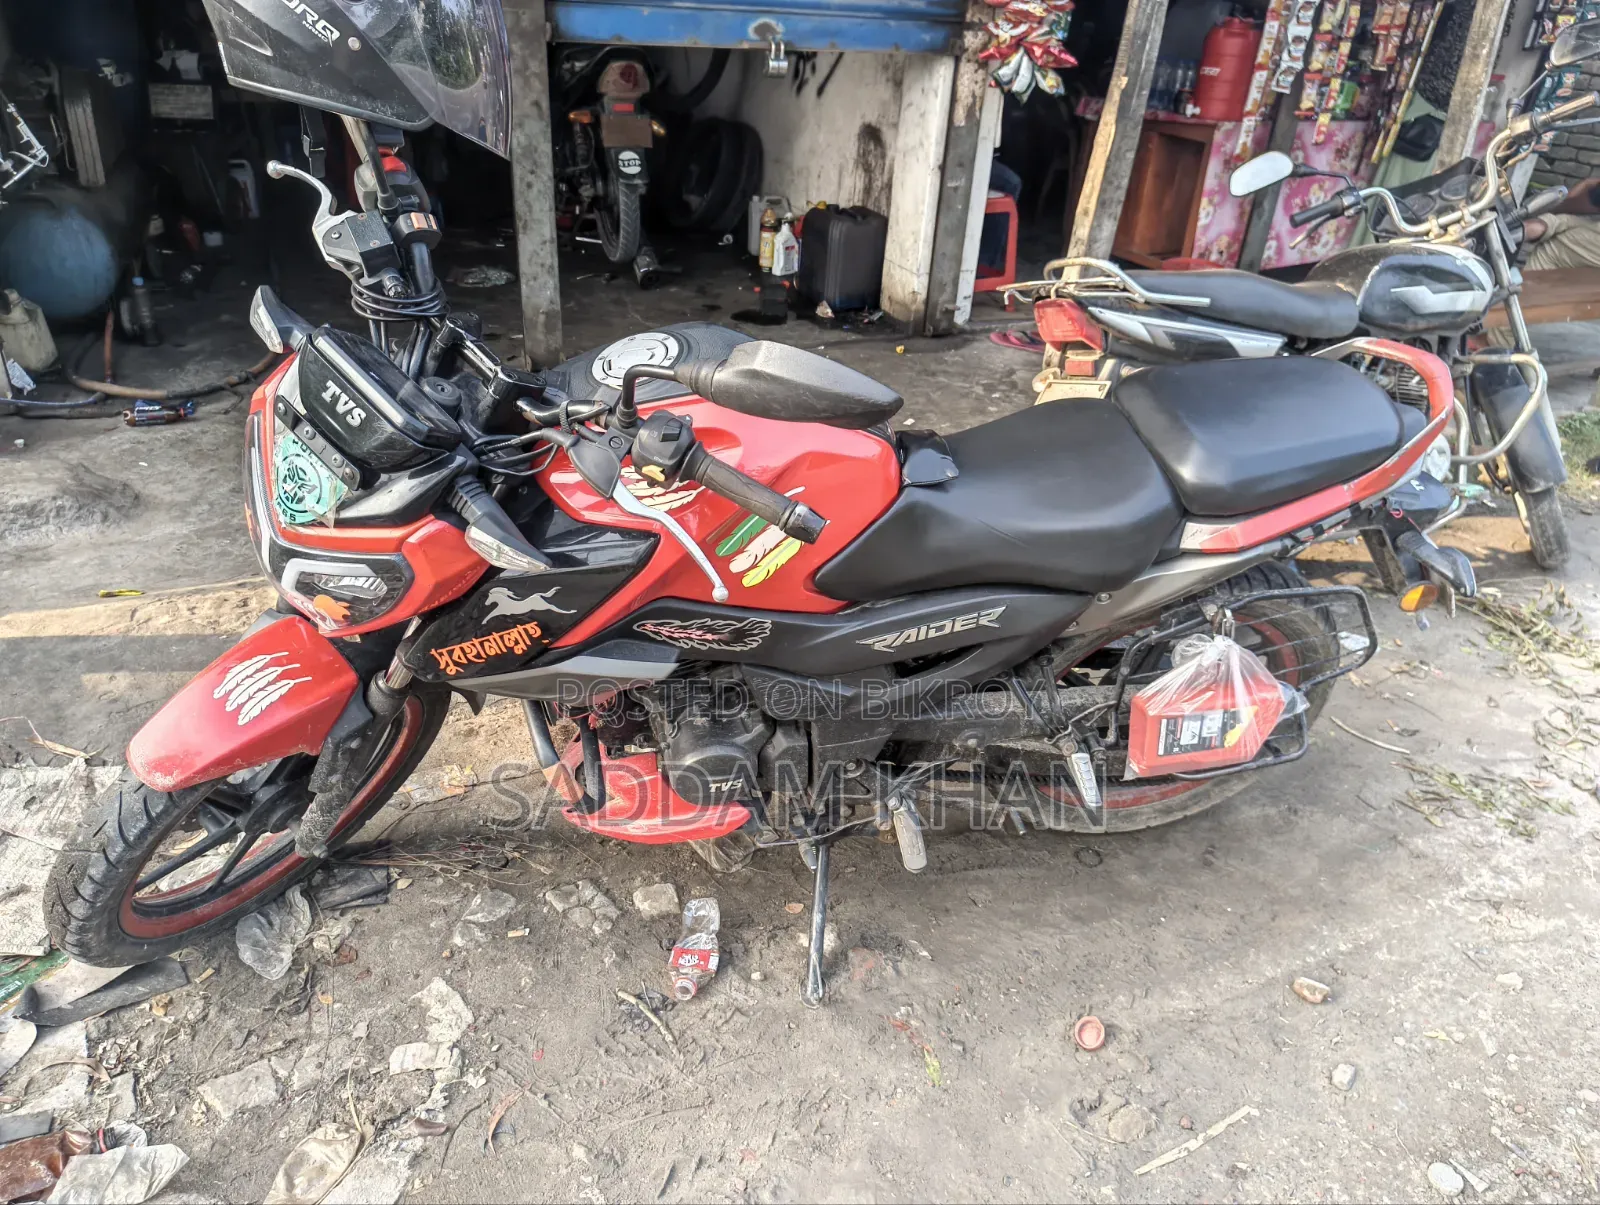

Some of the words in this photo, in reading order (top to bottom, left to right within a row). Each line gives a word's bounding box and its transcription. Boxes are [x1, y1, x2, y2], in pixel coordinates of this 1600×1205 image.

[321, 380, 367, 428] TVS
[855, 605, 1007, 653] RAIDER
[708, 778, 744, 793] TVS
